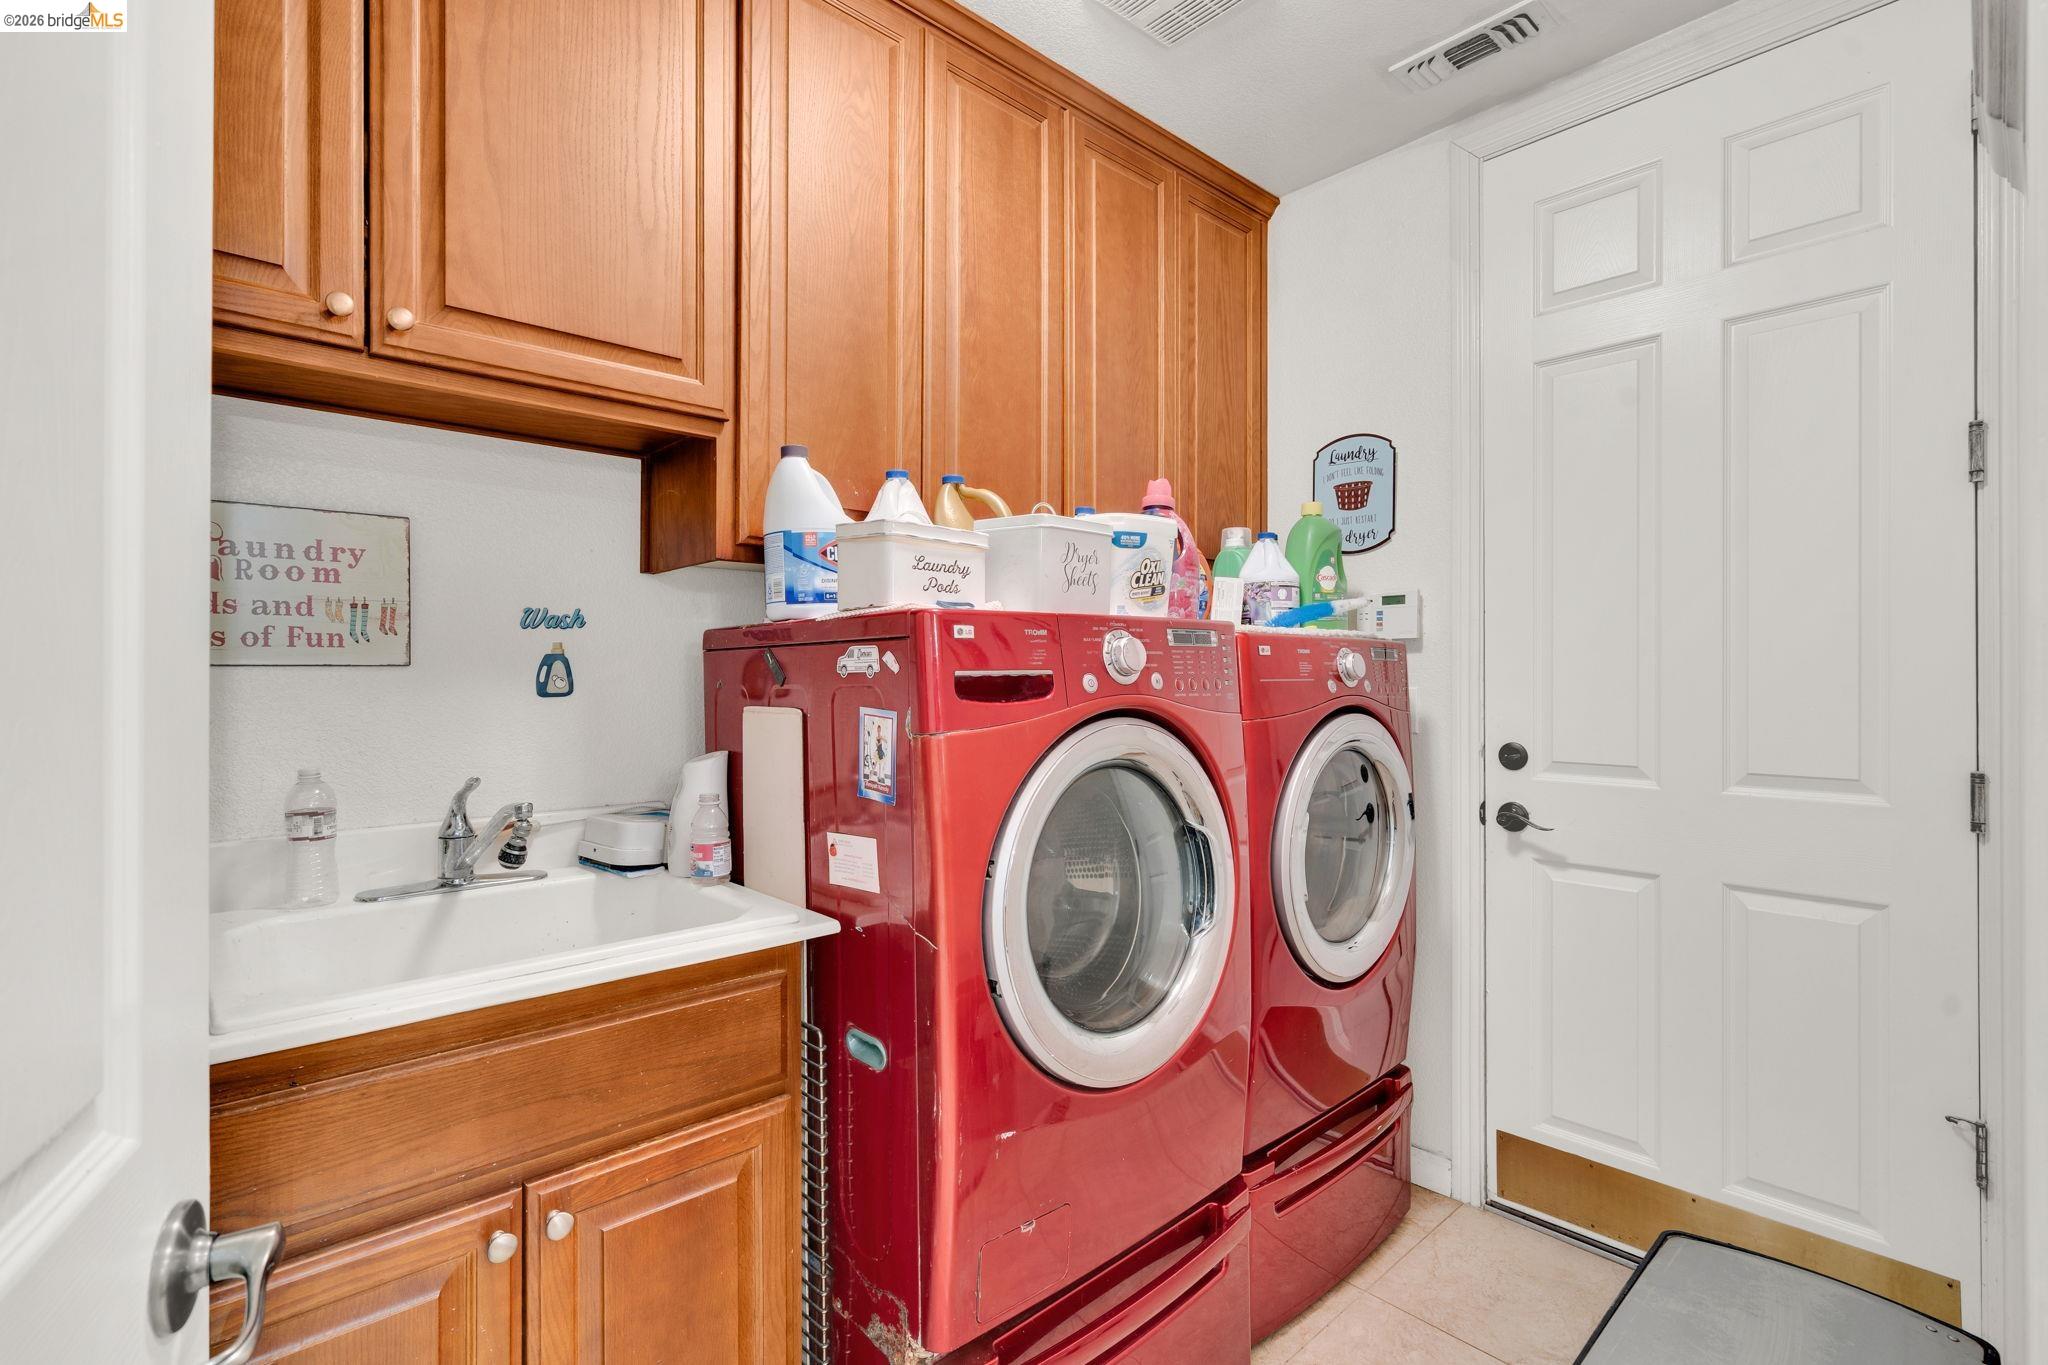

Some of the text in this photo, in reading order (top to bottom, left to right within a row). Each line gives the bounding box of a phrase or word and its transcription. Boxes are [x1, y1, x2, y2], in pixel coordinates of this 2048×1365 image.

[1329, 445, 1378, 465] Laundry
[1341, 467, 1352, 477] FEEL
[1354, 466, 1365, 475] LIKE
[1366, 465, 1384, 477] FOLDING
[1341, 516, 1353, 526] JUST
[1355, 514, 1377, 525] RESTART
[1345, 529, 1378, 547] dryer
[912, 555, 972, 579] Laundry
[1061, 542, 1099, 573] Dryer
[1140, 557, 1161, 574] OXI
[234, 558, 342, 584] Room
[1062, 563, 1099, 596] Sheets
[1130, 570, 1166, 590] CLEAN
[922, 576, 961, 594] Pods
[251, 595, 315, 617] and
[520, 606, 587, 629] Wash
[240, 625, 275, 648] of
[286, 626, 345, 648] Fun
